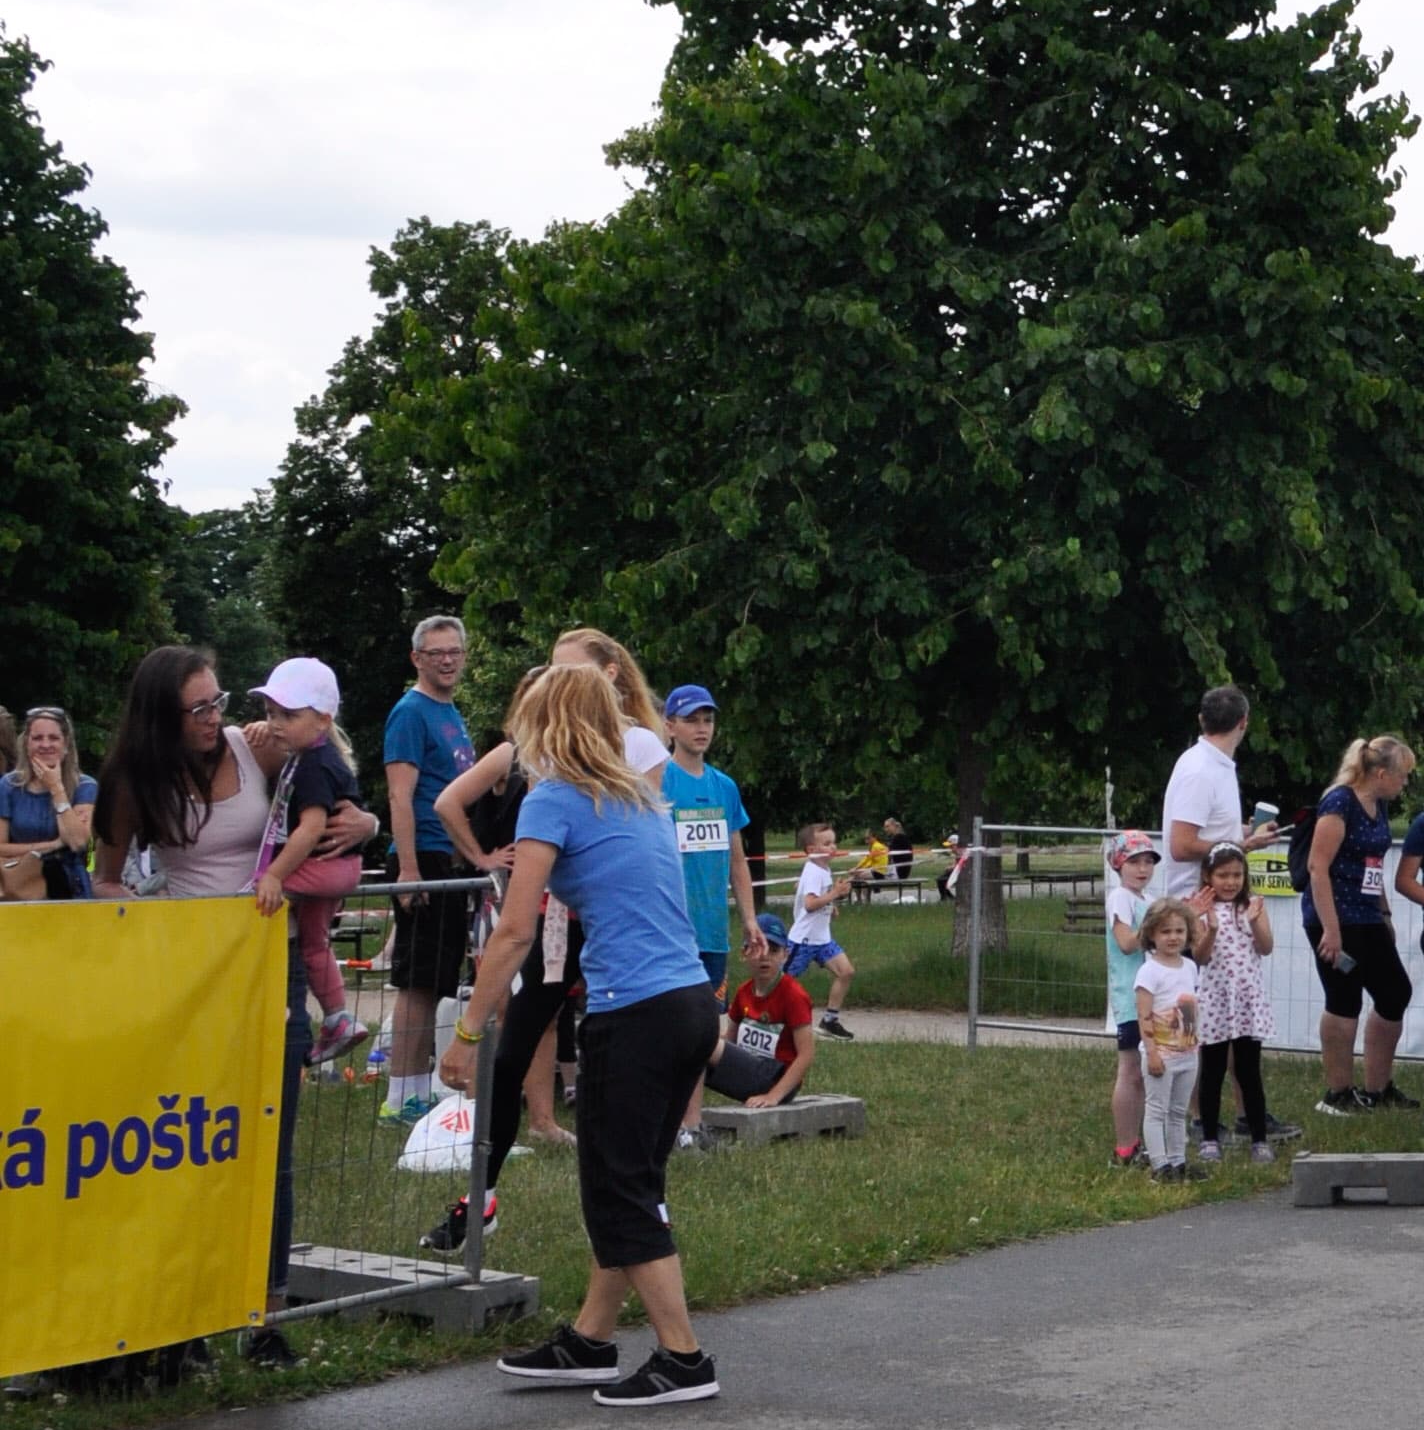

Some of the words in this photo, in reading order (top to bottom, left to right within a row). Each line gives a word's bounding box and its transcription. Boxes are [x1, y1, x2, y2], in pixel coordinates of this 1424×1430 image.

[685, 823, 721, 841] 2011
[1365, 870, 1384, 886] 30
[742, 1026, 773, 1052] 2012
[65, 1093, 241, 1200] pošta
